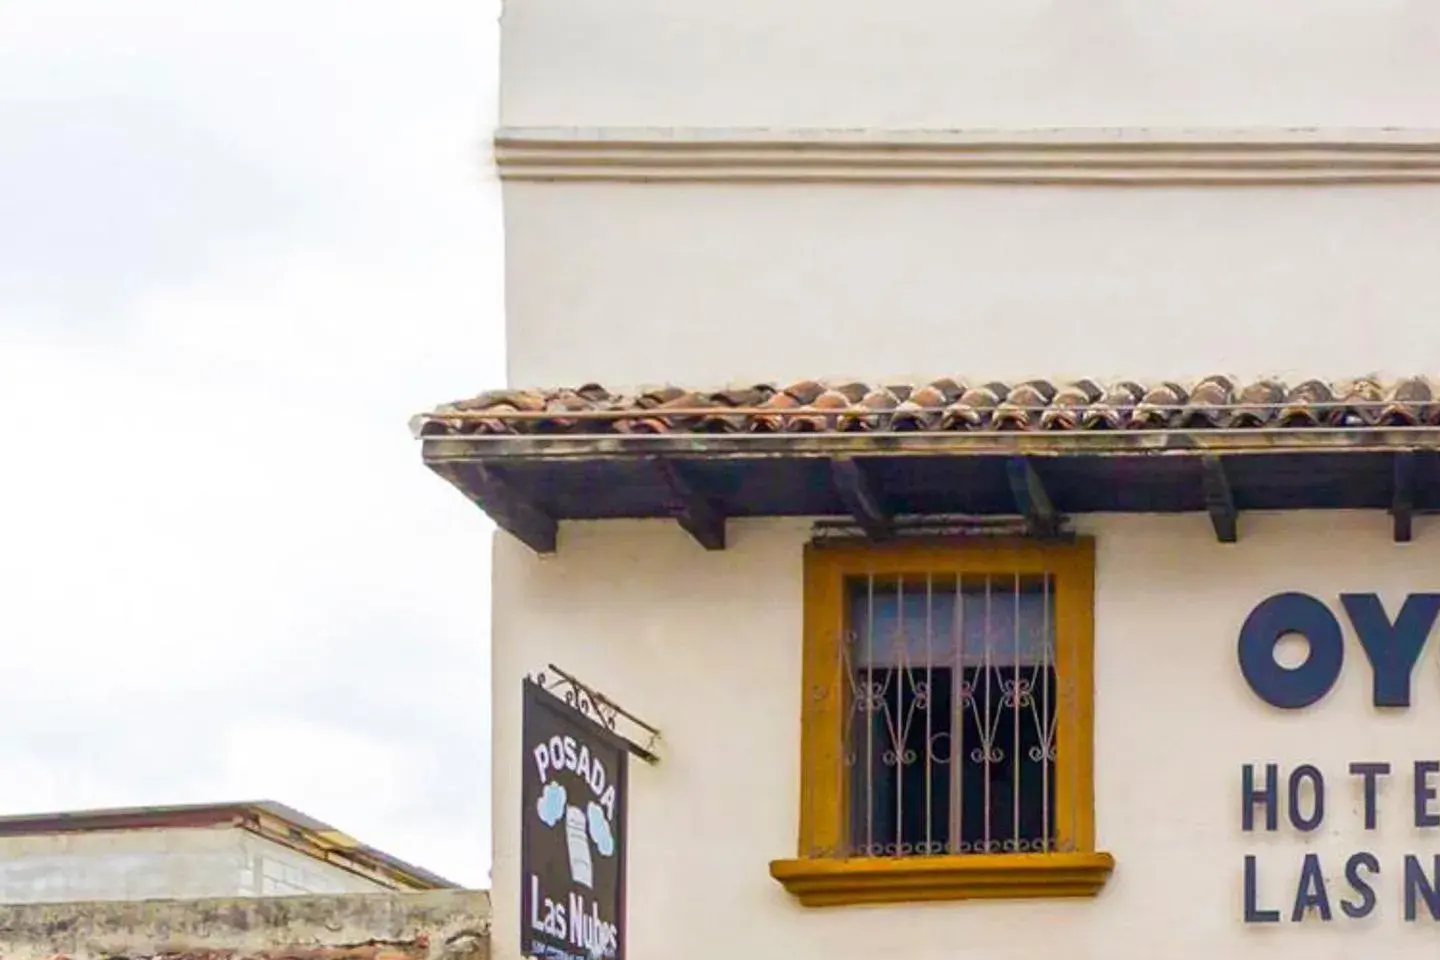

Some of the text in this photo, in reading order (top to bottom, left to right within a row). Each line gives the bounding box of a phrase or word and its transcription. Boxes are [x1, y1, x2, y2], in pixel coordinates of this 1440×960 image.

[533, 734, 616, 821] POSADA
[531, 873, 567, 939] Las
[1243, 851, 1380, 923] LAS
